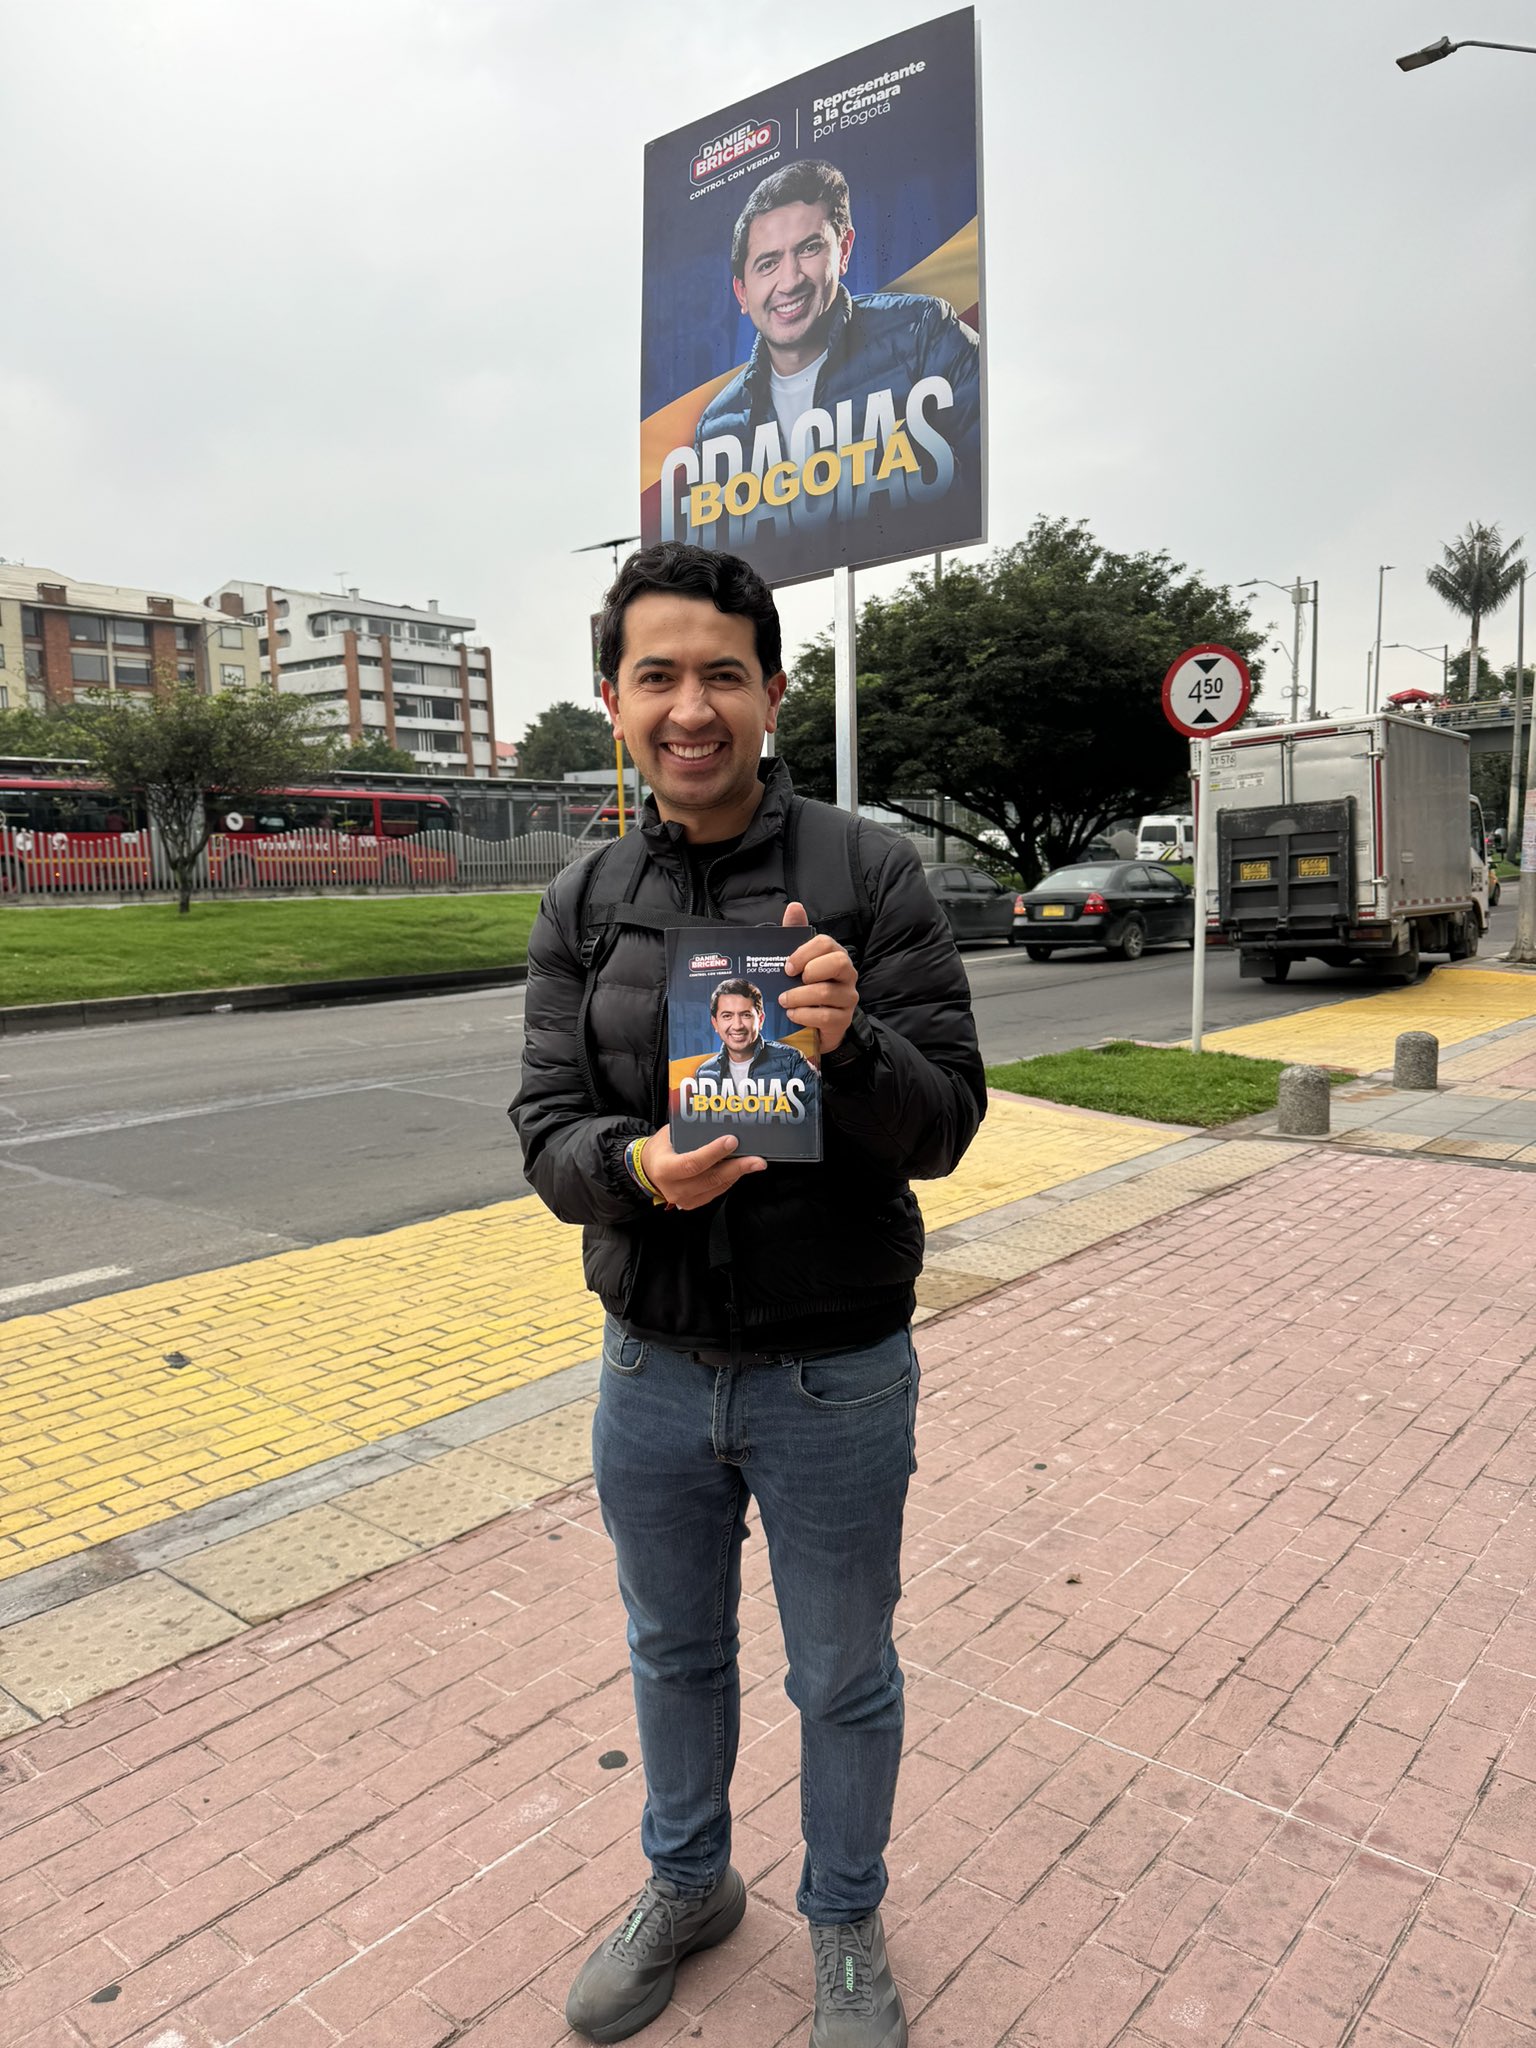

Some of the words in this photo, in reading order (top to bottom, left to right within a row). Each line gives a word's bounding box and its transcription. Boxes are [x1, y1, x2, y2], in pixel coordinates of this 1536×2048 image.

[812, 60, 927, 113] Representante
[812, 114, 823, 127] a
[825, 107, 839, 122] la
[841, 84, 901, 114] Cámara
[703, 124, 755, 160] DANIEL
[813, 121, 837, 143] por
[840, 98, 891, 129] Bogotá
[689, 177, 727, 200] CONTROL
[727, 168, 745, 182] CON
[746, 151, 781, 173] VERDAD
[660, 375, 955, 548] GRACIAS
[690, 417, 921, 528] BOGOTÁ
[679, 1076, 806, 1125] GRACIAS
[693, 1091, 793, 1114] BOGOTÁ
[845, 1955, 854, 1993] ADIZERO
